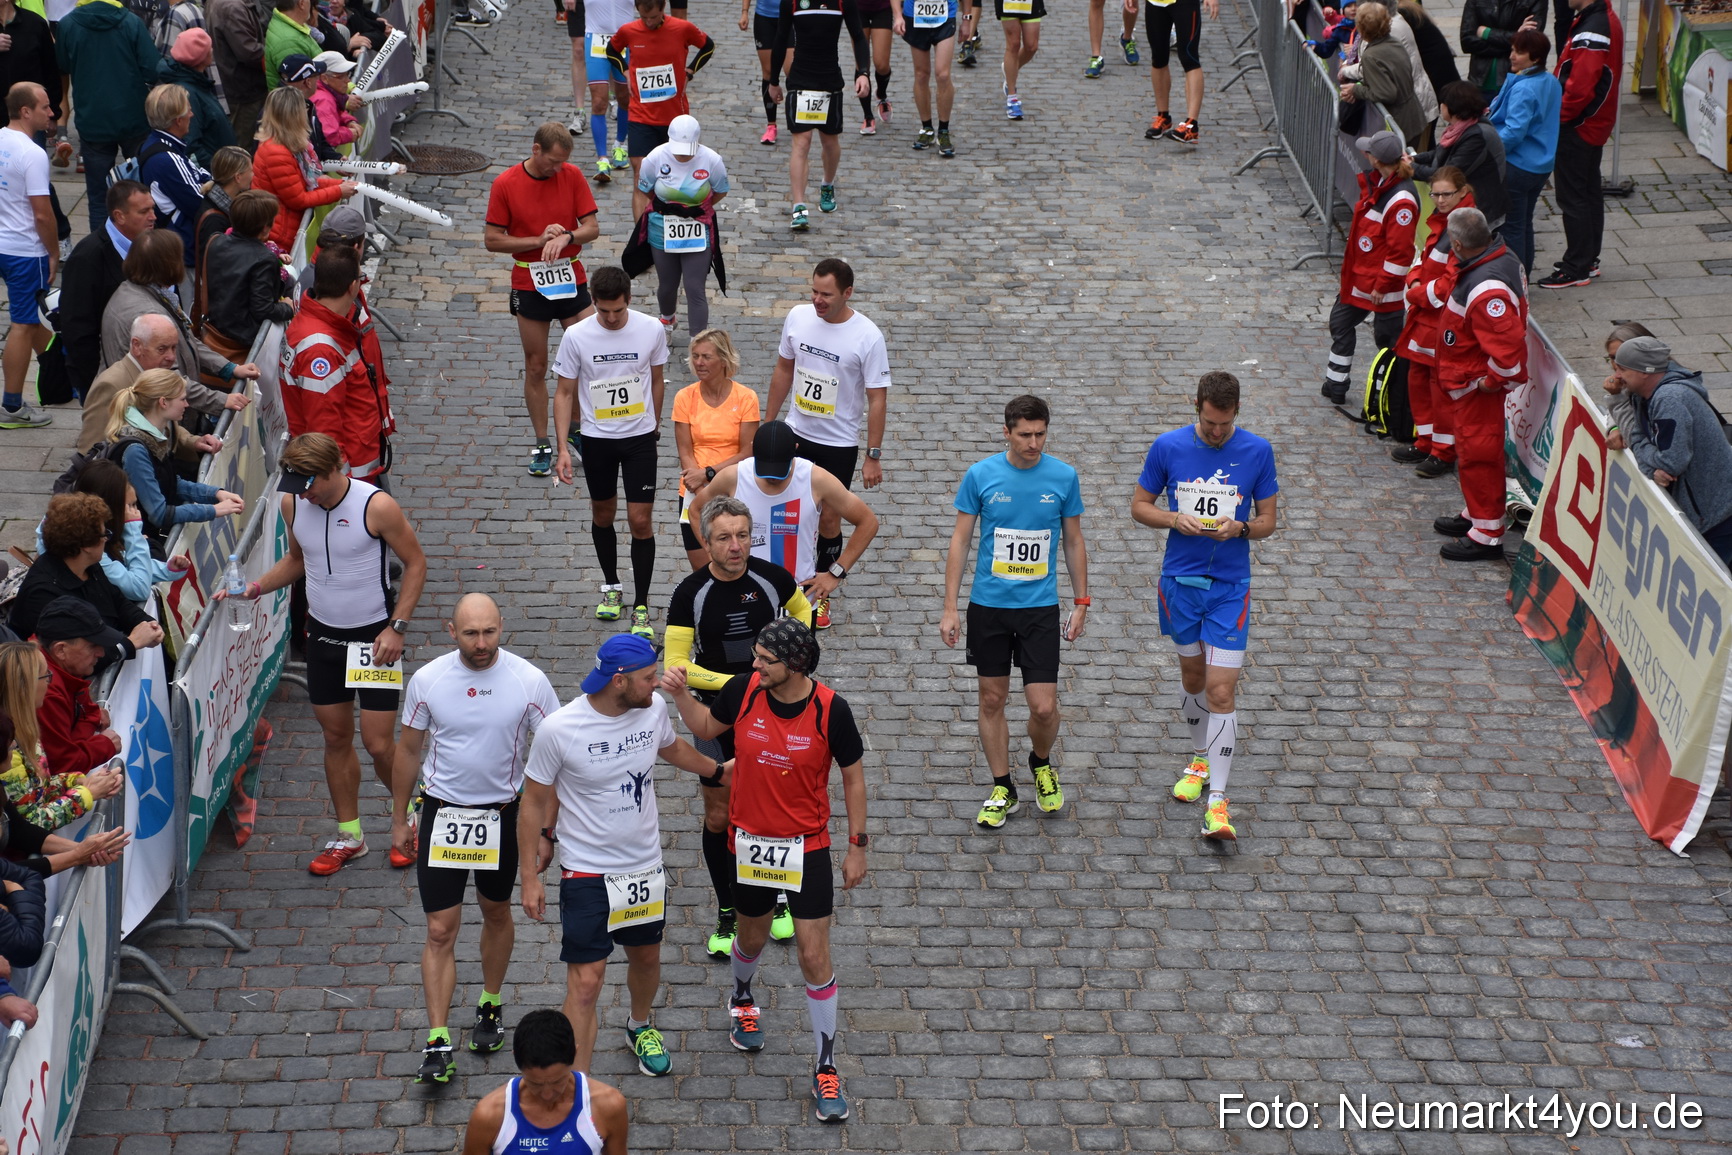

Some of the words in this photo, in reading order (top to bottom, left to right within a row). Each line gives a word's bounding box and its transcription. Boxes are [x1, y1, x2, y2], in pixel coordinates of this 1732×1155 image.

[917, 4, 945, 15] 2024
[356, 68, 374, 91] BMW
[373, 33, 400, 70] Laufsport
[640, 74, 672, 89] 2764
[649, 90, 666, 98] Jürgen
[805, 99, 823, 111] 152
[668, 223, 702, 238] 3070
[535, 268, 572, 286] 3015
[608, 379, 633, 388] Neumarkt
[808, 374, 830, 385] Neumarkt
[607, 387, 629, 405] 79
[804, 380, 822, 400] 78
[799, 399, 825, 413] Wolfgang
[610, 408, 630, 417] Frank
[1194, 496, 1218, 516] 46
[1006, 542, 1040, 561] 190
[1008, 566, 1034, 574] Steffen
[354, 670, 396, 682] URBEL
[688, 671, 713, 679] saucony
[446, 822, 487, 846] 379
[442, 850, 487, 861] Alexander
[749, 844, 790, 868] 247
[629, 869, 655, 879] Neumarkt
[753, 869, 787, 881] Michael
[628, 880, 650, 905] 35
[624, 907, 648, 919] Daniel
[519, 1138, 549, 1146] HEITEC
